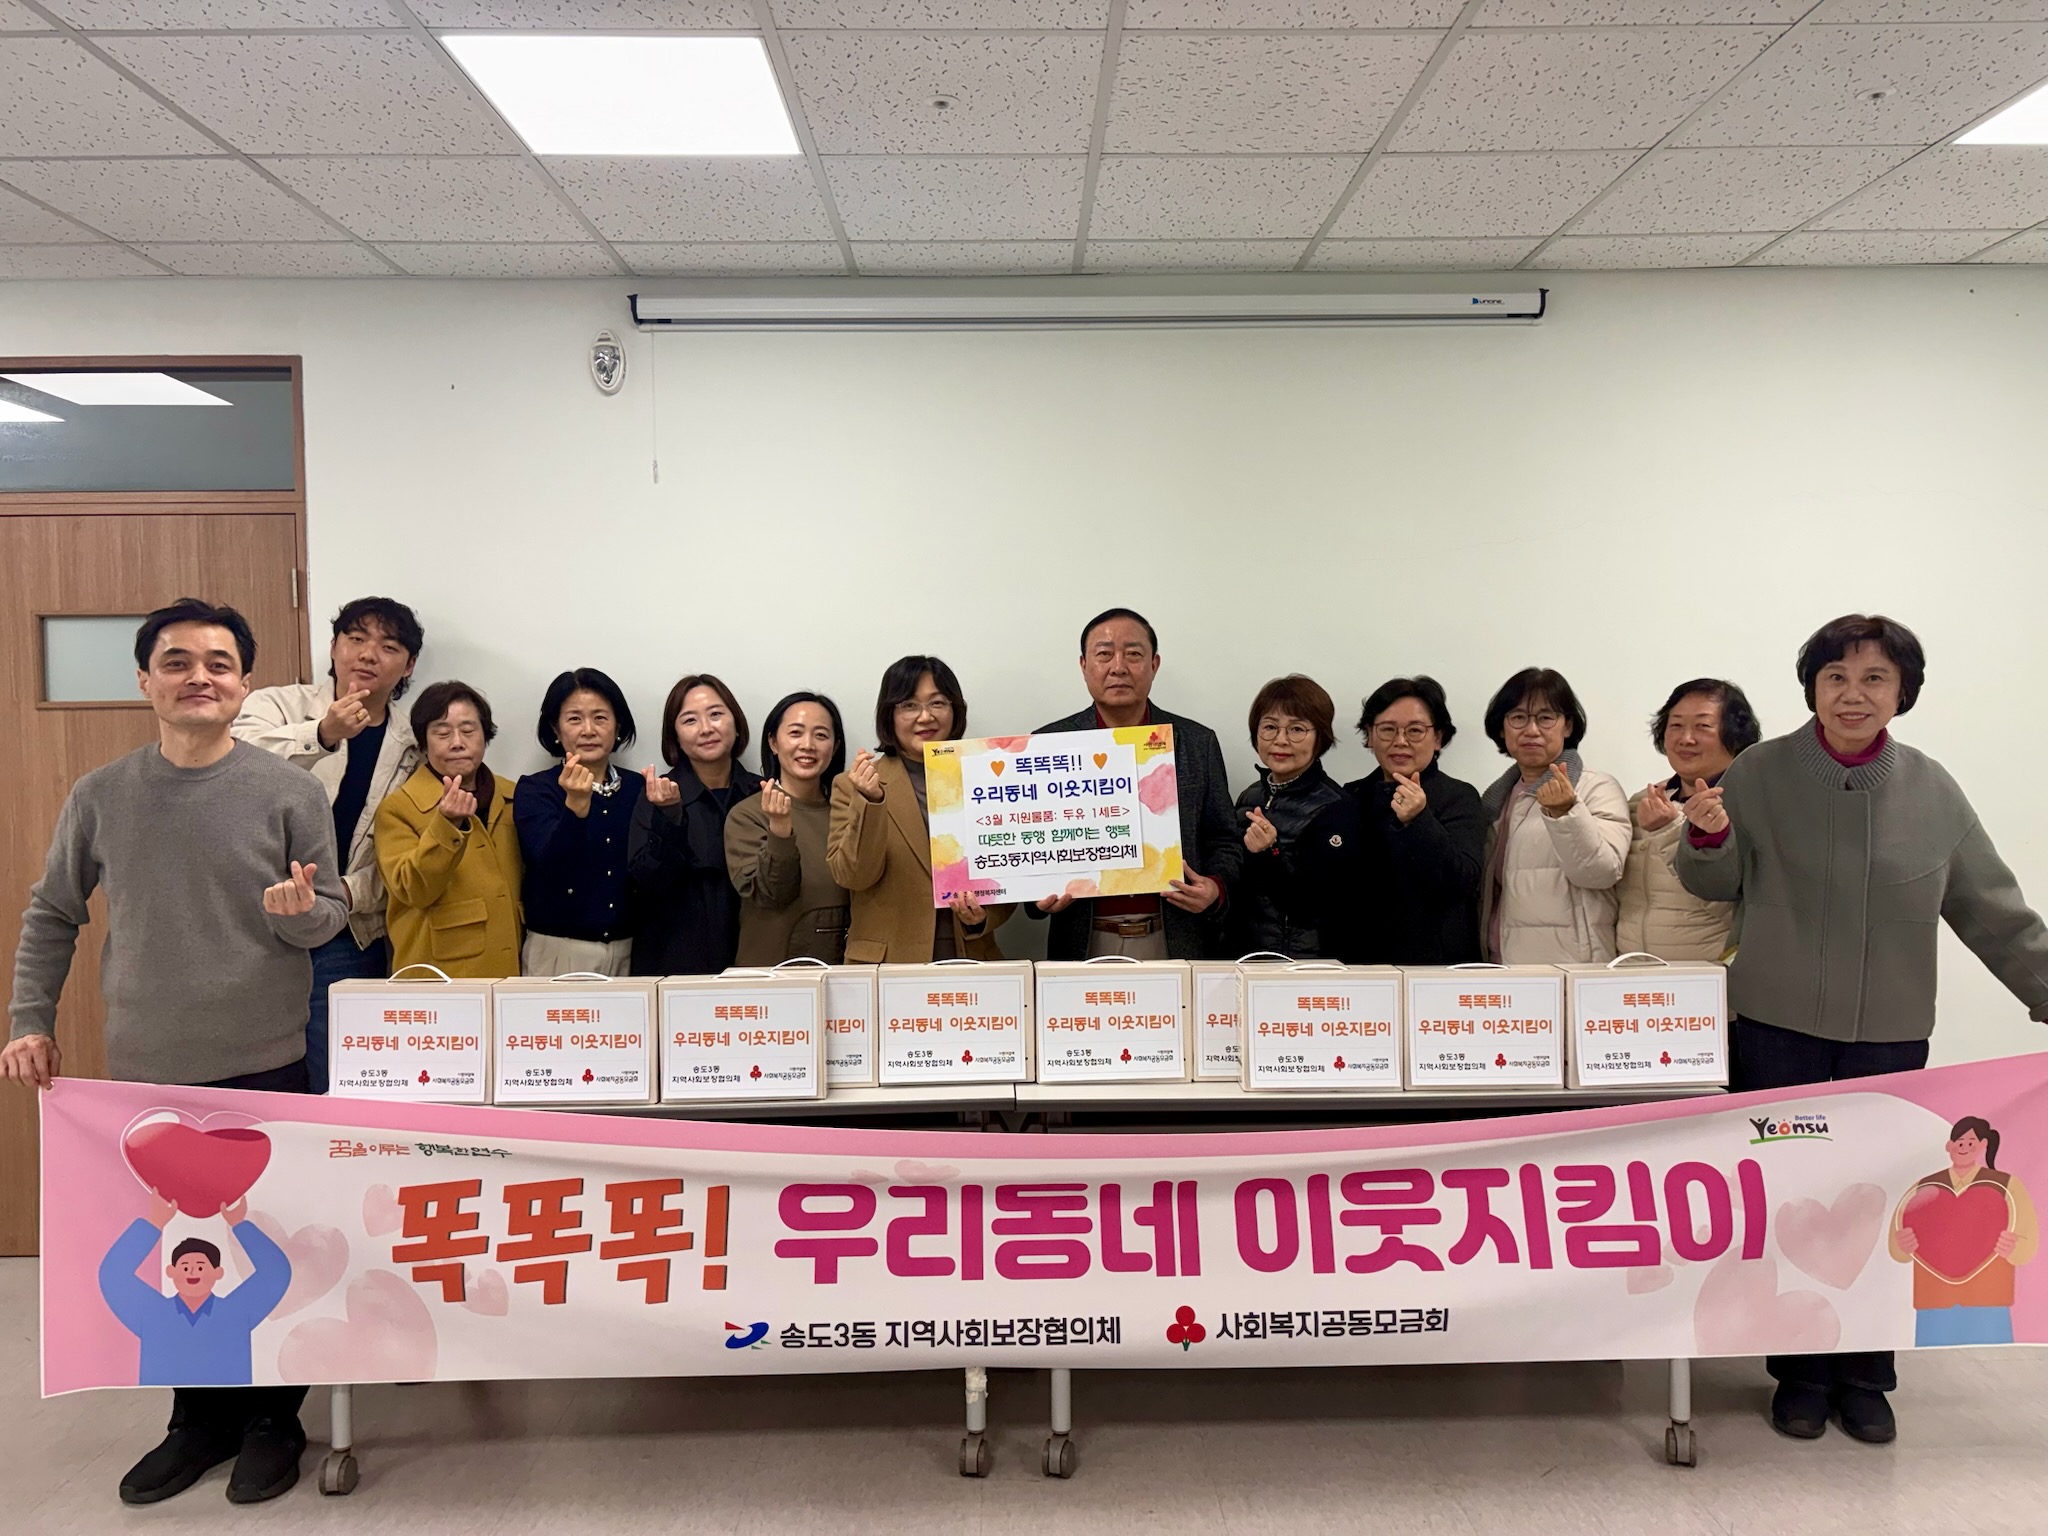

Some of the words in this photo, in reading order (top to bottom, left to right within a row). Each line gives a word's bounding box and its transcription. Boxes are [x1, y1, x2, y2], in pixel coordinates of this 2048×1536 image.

[1015, 754, 1083, 775] 똑똑똑!!
[971, 783, 1038, 804] 우리동네
[1047, 776, 1132, 799] 이웃지킴이
[976, 813, 1004, 827] <3월
[1009, 810, 1058, 825] 지원물품:
[1063, 808, 1086, 821] 두유
[1091, 805, 1131, 820] 1세트>
[978, 832, 1017, 848] 따뜻한
[1020, 829, 1046, 846] 동행
[1051, 826, 1101, 843] 함께하는
[1105, 824, 1131, 840] 행복
[926, 992, 978, 1007] 똑똑똑!!
[1085, 991, 1136, 1006] 똑똑똑!!
[1297, 996, 1350, 1011] 똑똑똑!!
[1458, 994, 1512, 1009] 똑똑똑!!
[1622, 992, 1675, 1008] 똑똑똑!!
[383, 1009, 438, 1025] 똑똑똑!!
[546, 1009, 600, 1024] 똑똑똑!!
[714, 1005, 768, 1020] 똑똑똑!!
[888, 1017, 943, 1033] 우리동네
[949, 1015, 1018, 1032] 이웃지킴이
[1047, 1017, 1100, 1032] 우리동네
[1108, 1015, 1175, 1031] 이웃지킴이
[1257, 1022, 1314, 1038] 우리동네
[1321, 1021, 1391, 1037] 이웃지킴이
[1418, 1019, 1475, 1036] 우리동네
[1482, 1018, 1552, 1035] 이웃지킴이
[1584, 1018, 1639, 1035] 우리동네
[1646, 1016, 1716, 1033] 이웃지킴이
[341, 1035, 400, 1051] 우리동네
[407, 1035, 479, 1051] 이웃지킴이
[505, 1034, 562, 1050] 우리동네
[570, 1033, 642, 1049] 이웃지킴이
[673, 1031, 730, 1048] 우리동네
[738, 1030, 809, 1047] 이웃지킴이
[907, 1050, 933, 1058] 송도3동
[1066, 1048, 1092, 1057] 송도3동
[1277, 1055, 1305, 1063] 송도3동
[1438, 1052, 1465, 1061] 송도3동
[1604, 1052, 1631, 1060] 송도3동
[360, 1069, 388, 1078] 송도3동
[525, 1068, 552, 1076] 송도3동
[692, 1065, 720, 1074] 송도3동
[1749, 1117, 1829, 1140] Yeonsu
[392, 1177, 731, 1305] 똑똑똑!
[774, 1179, 1202, 1285] 우리동네
[1233, 1158, 1768, 1275] 이웃지킴이
[779, 1321, 877, 1349] 송도3동
[885, 1315, 1121, 1349] 지역사회보장협의체
[1215, 1307, 1450, 1341] 사회복지공동모금회
